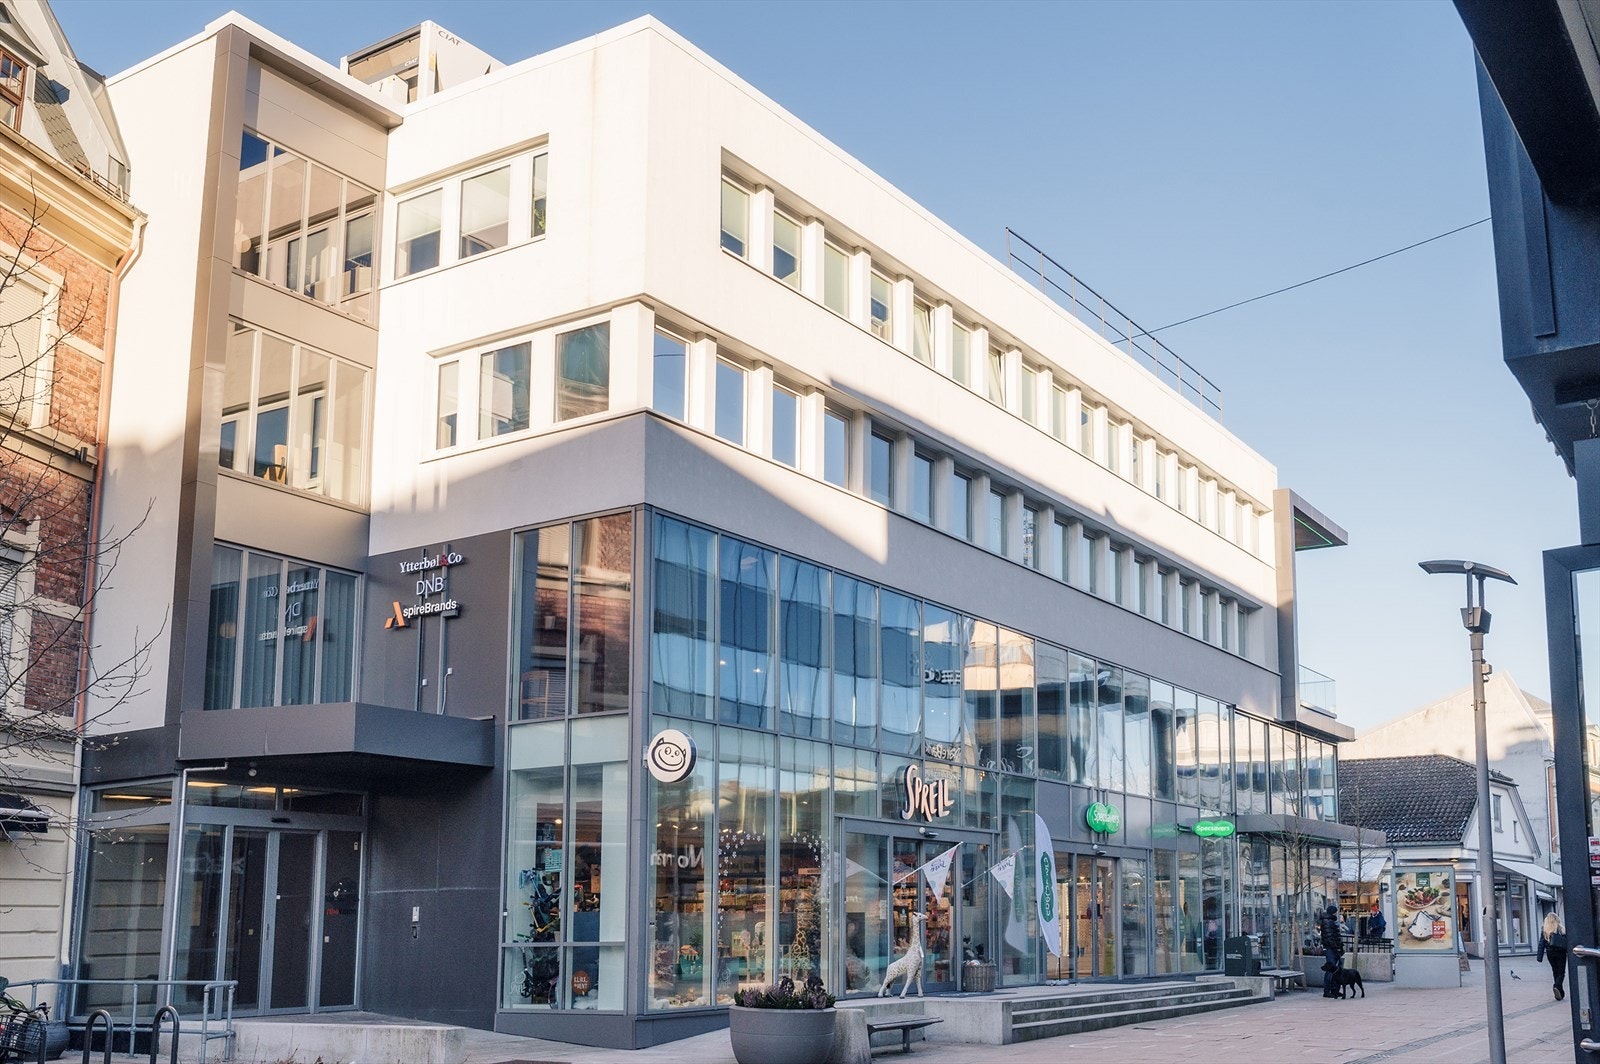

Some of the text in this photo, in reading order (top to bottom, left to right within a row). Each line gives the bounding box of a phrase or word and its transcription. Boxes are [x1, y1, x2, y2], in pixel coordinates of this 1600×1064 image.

[438, 30, 462, 46] CIAT
[416, 573, 444, 599] DNB
[1196, 825, 1231, 833] Specsavers
